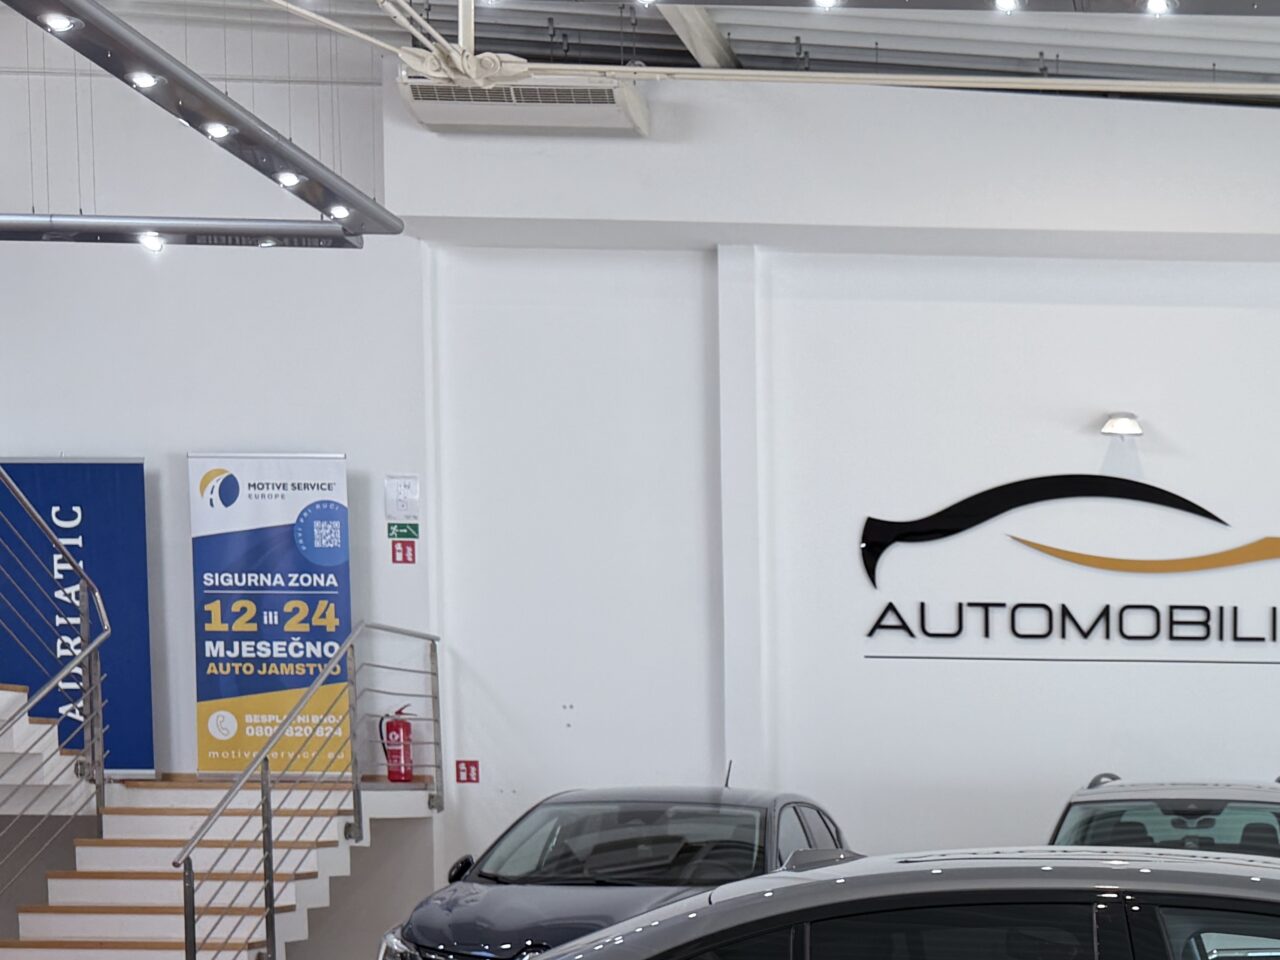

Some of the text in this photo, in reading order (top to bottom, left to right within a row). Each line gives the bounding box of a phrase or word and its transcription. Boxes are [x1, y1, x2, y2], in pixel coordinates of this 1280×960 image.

[248, 482, 289, 492] MOTIVE
[203, 572, 338, 587] SIGURNA ZONA
[204, 599, 340, 632] 12 ili 24
[204, 636, 341, 659] MJESEČNO
[206, 662, 254, 675] AUTO
[245, 714, 309, 723] BESPLNI
